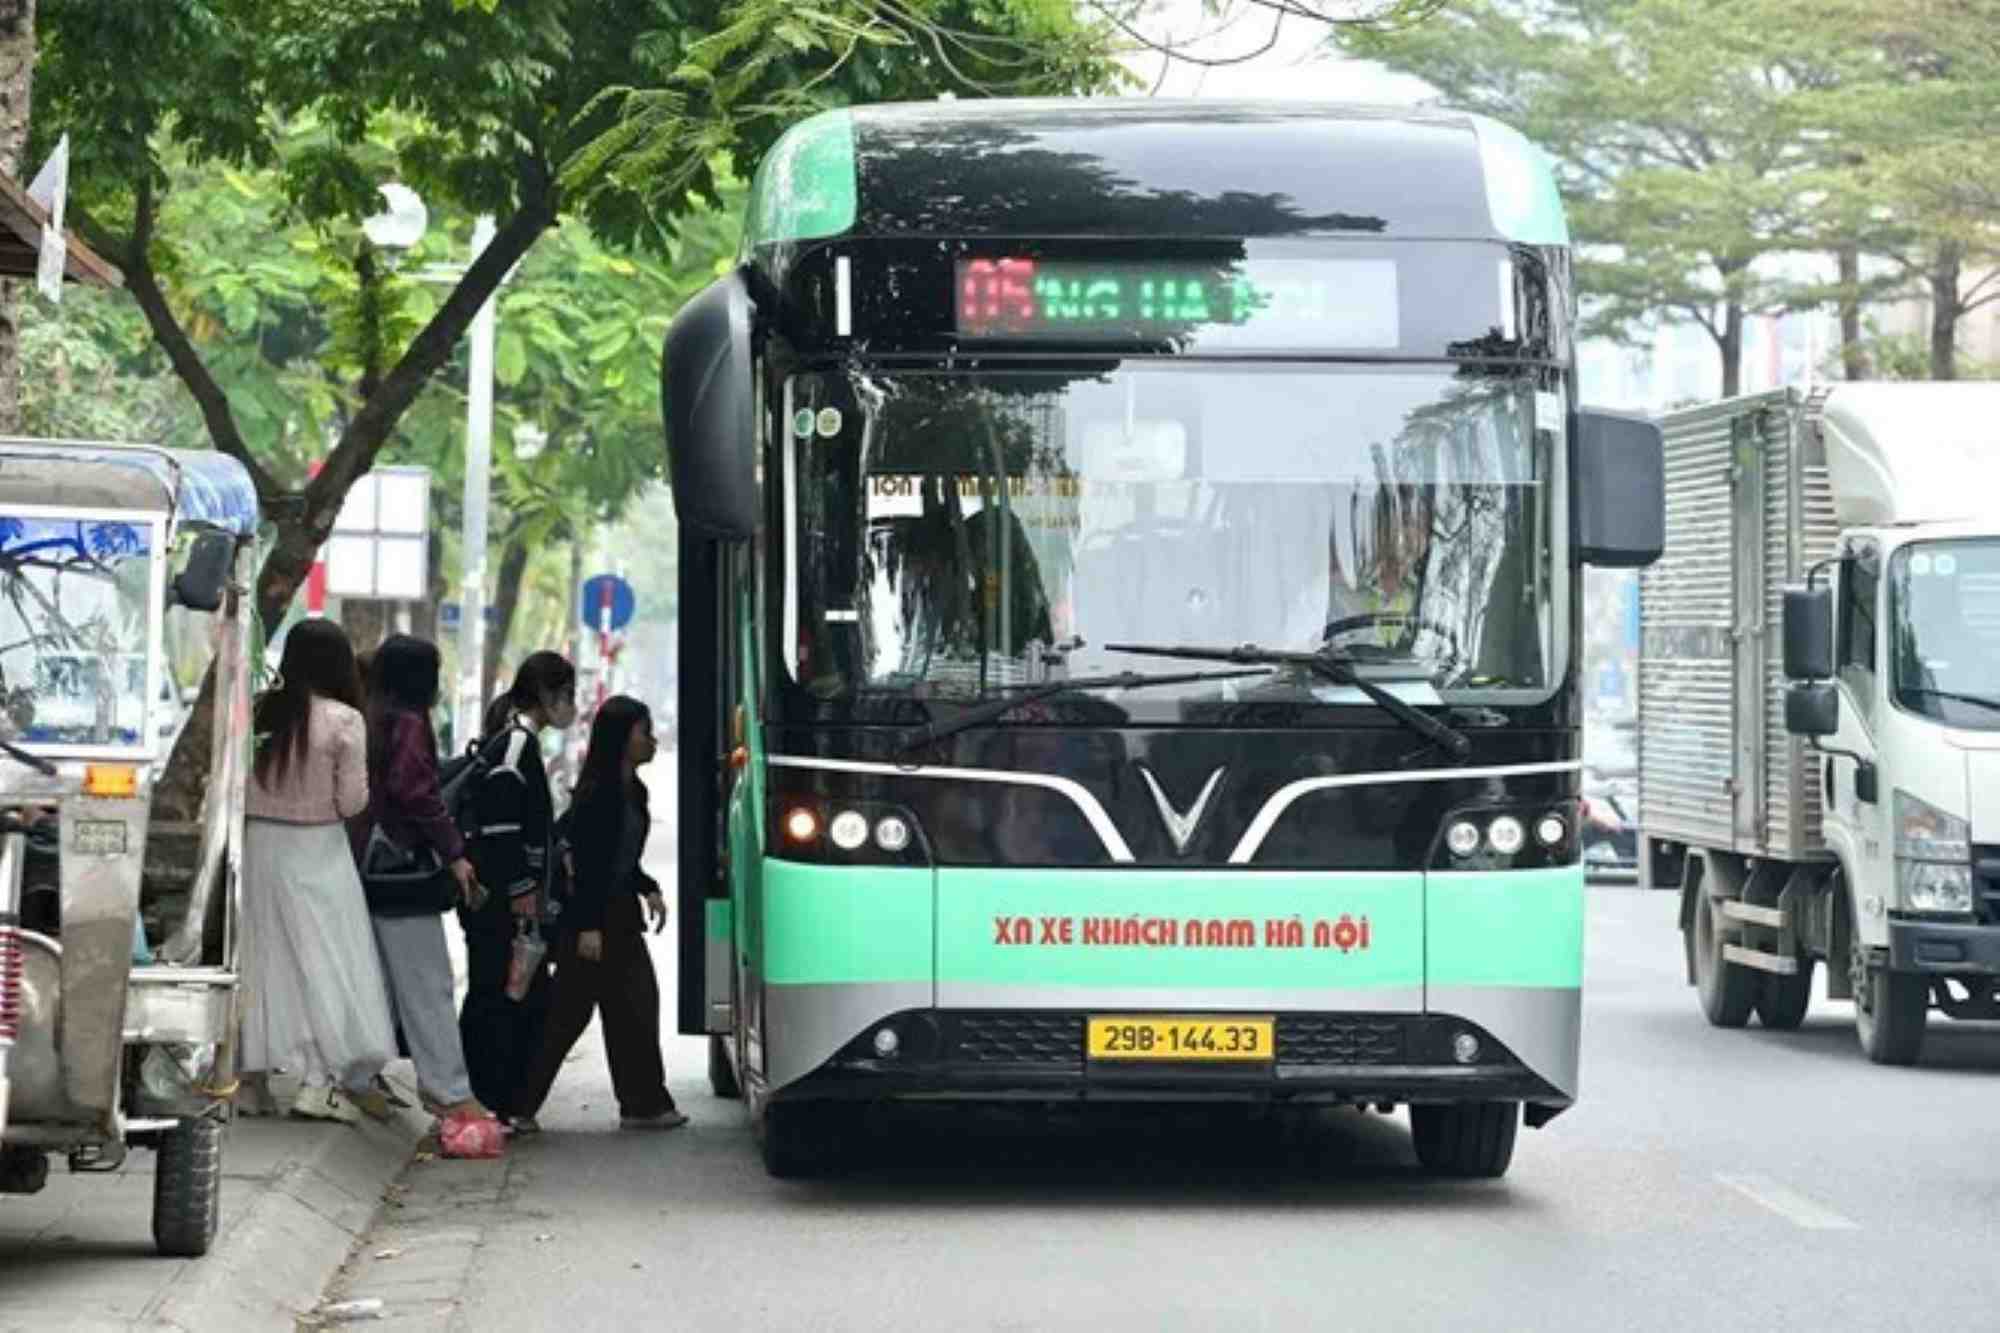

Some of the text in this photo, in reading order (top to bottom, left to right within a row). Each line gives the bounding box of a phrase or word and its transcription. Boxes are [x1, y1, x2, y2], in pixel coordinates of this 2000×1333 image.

[994, 916, 1032, 945] XN
[1041, 916, 1072, 945] XE
[1083, 912, 1177, 946] KHÁCH
[1184, 918, 1255, 947] NAM
[1104, 1025, 1258, 1051] 29B-144.33
